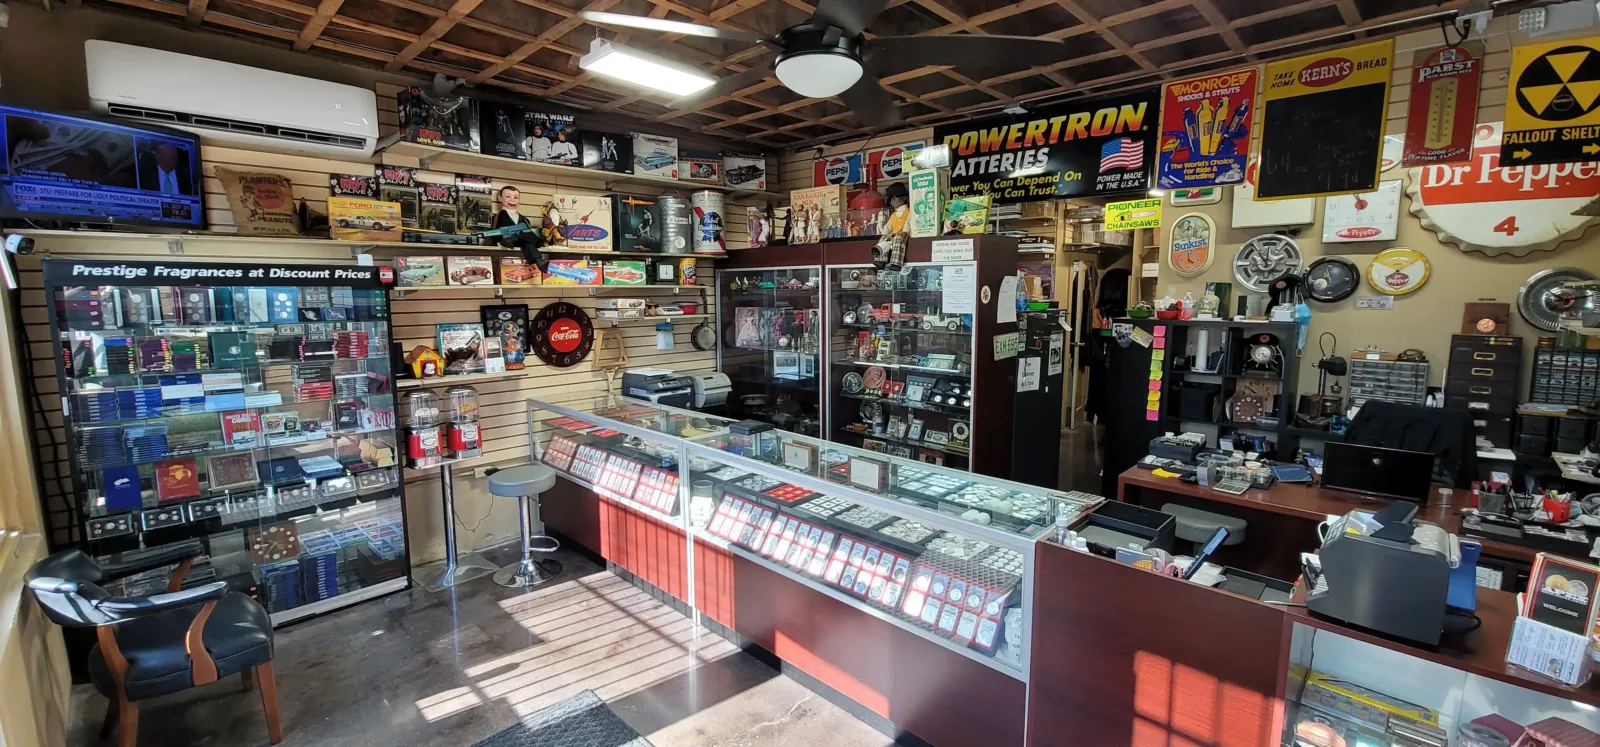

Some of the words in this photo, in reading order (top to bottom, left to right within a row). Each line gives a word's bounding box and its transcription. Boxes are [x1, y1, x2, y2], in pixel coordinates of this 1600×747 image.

[1356, 57, 1387, 71] BREAD
[1273, 70, 1295, 81] TAKE
[1300, 61, 1351, 83] KERN'S
[1417, 59, 1476, 83] PABST
[1173, 74, 1246, 95] MONROE
[1270, 78, 1296, 89] HOME
[1177, 92, 1203, 103] SHOCKS
[1211, 86, 1240, 97] STRUTS
[524, 111, 548, 120] STAR
[549, 114, 575, 122] WARS
[943, 101, 1148, 156] POWERTRON
[1503, 129, 1557, 145] FALLOUT
[1561, 125, 1600, 141] SHELT
[1440, 147, 1466, 160] FLAVOR
[950, 147, 1050, 178] ATTERIES
[1170, 163, 1183, 171] The
[1184, 160, 1209, 169] World's
[1210, 158, 1235, 166] Choice
[826, 167, 848, 177] PEPSI
[1096, 173, 1121, 183] POWER
[1122, 170, 1144, 180] MADE
[1184, 172, 1215, 181] Handling
[1423, 163, 1472, 189] Dr
[951, 183, 971, 193] wer
[972, 180, 991, 192] You
[993, 178, 1014, 189] Can
[1016, 170, 1061, 188] Depend
[1064, 170, 1082, 182] On
[1095, 182, 1104, 191] IN
[1105, 181, 1120, 190] THE
[15, 184, 33, 194] FOX
[983, 188, 1001, 200] You
[1004, 187, 1026, 198] Can
[1029, 184, 1059, 197] Trust.
[54, 190, 79, 198] PREPARE
[109, 194, 137, 203] POLITICAL
[1107, 199, 1162, 212] PIONEER
[258, 216, 294, 224] PEANUTS
[1106, 219, 1160, 231] CHAINSAWS
[1493, 215, 1519, 236] 4
[1174, 238, 1208, 252] Sunkist
[72, 264, 147, 277] Prestige
[153, 264, 242, 279] Fragrances
[248, 266, 264, 278] at
[269, 267, 330, 279] Discount
[334, 268, 371, 280] Prices
[558, 305, 567, 313] 12
[537, 319, 547, 328] 10
[582, 316, 588, 324] 2
[536, 333, 542, 342] 9
[586, 328, 592, 336] 3
[541, 346, 548, 355] 8
[576, 351, 582, 360] 5
[551, 354, 557, 363] 7
[564, 355, 570, 364] 6
[1542, 602, 1579, 618] WELCOME
